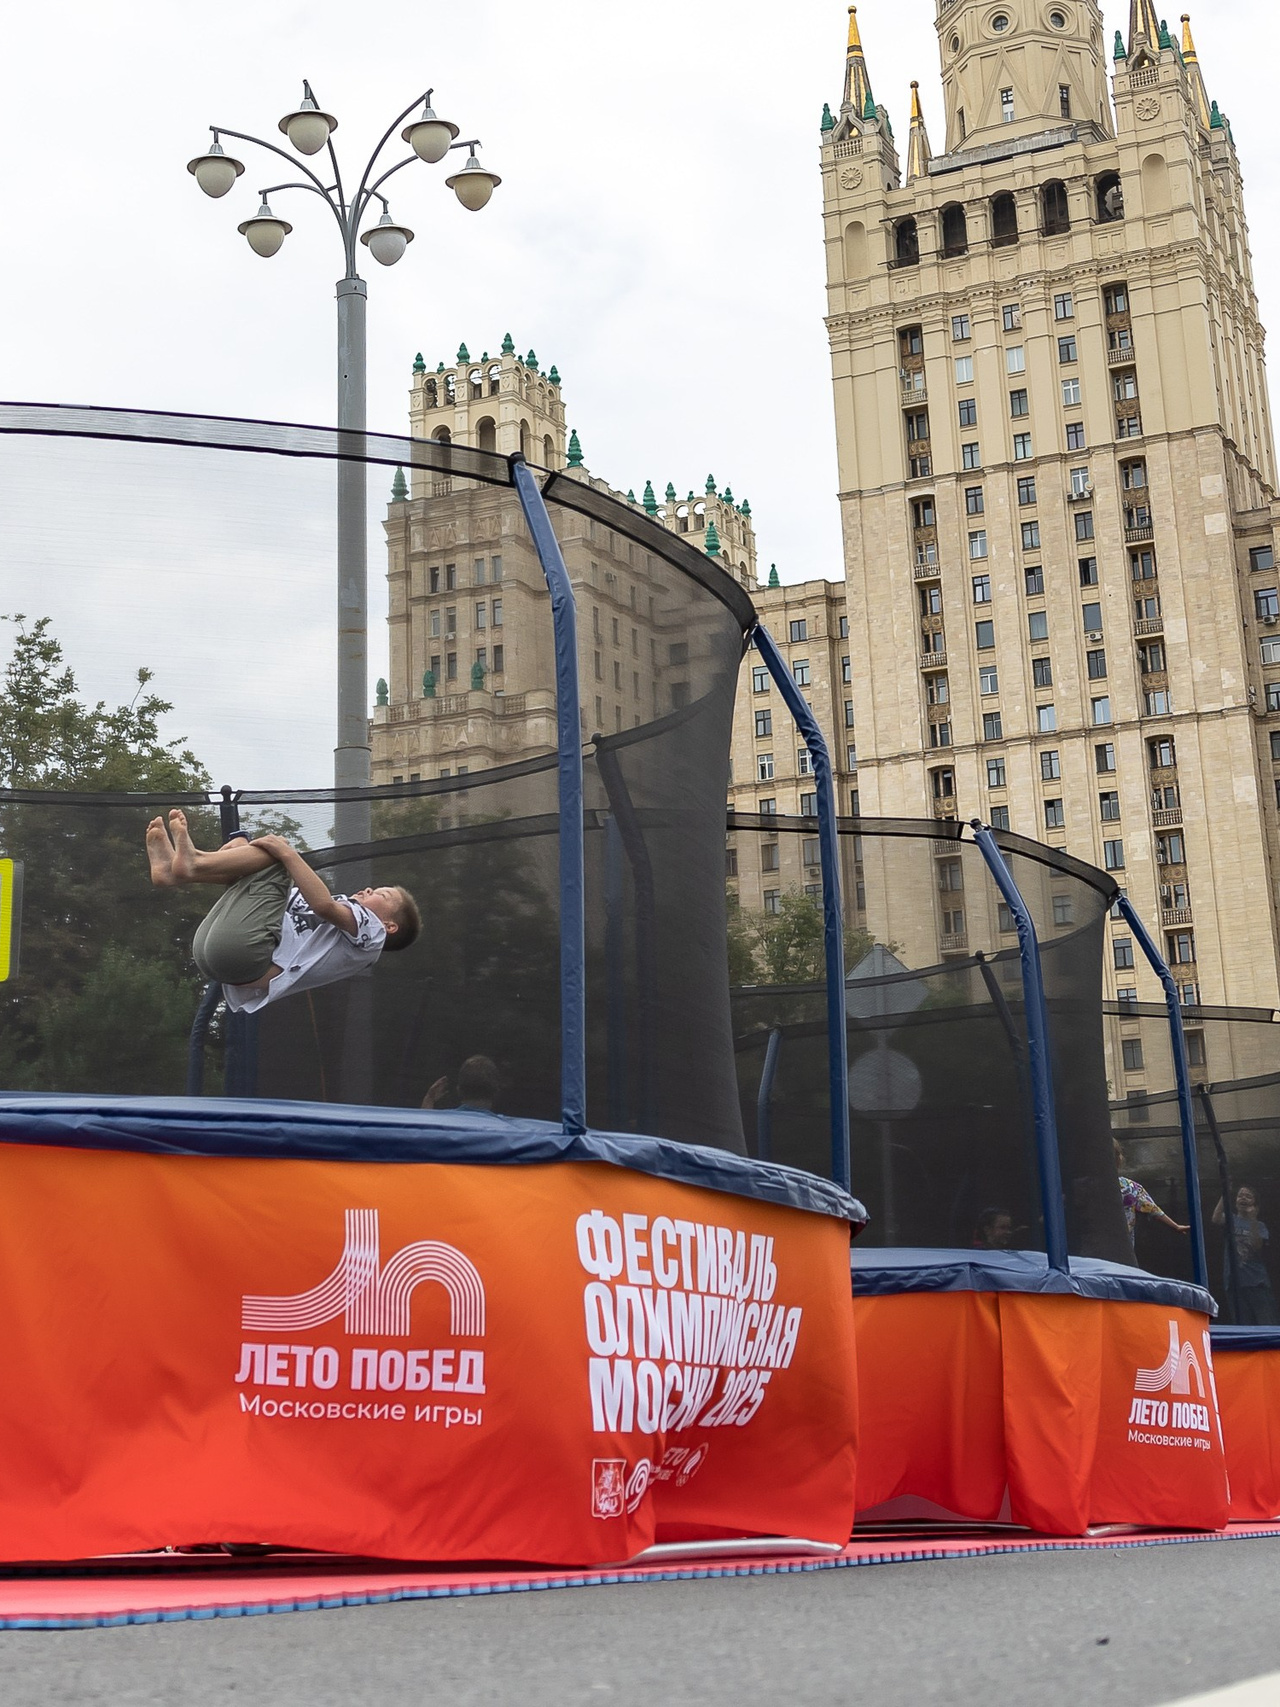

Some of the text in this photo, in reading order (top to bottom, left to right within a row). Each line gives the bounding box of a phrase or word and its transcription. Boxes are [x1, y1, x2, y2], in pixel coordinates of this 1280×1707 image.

[575, 1209, 778, 1304] ФЕСТИВАЛЬ
[234, 1342, 486, 1395] ЛЕТО ПОБЕД
[238, 1392, 483, 1429] Московские игры
[698, 1369, 773, 1427] 2025
[1128, 1398, 1210, 1433] ЛЕТО ПОБЕД
[1128, 1429, 1211, 1451] Московские игры
